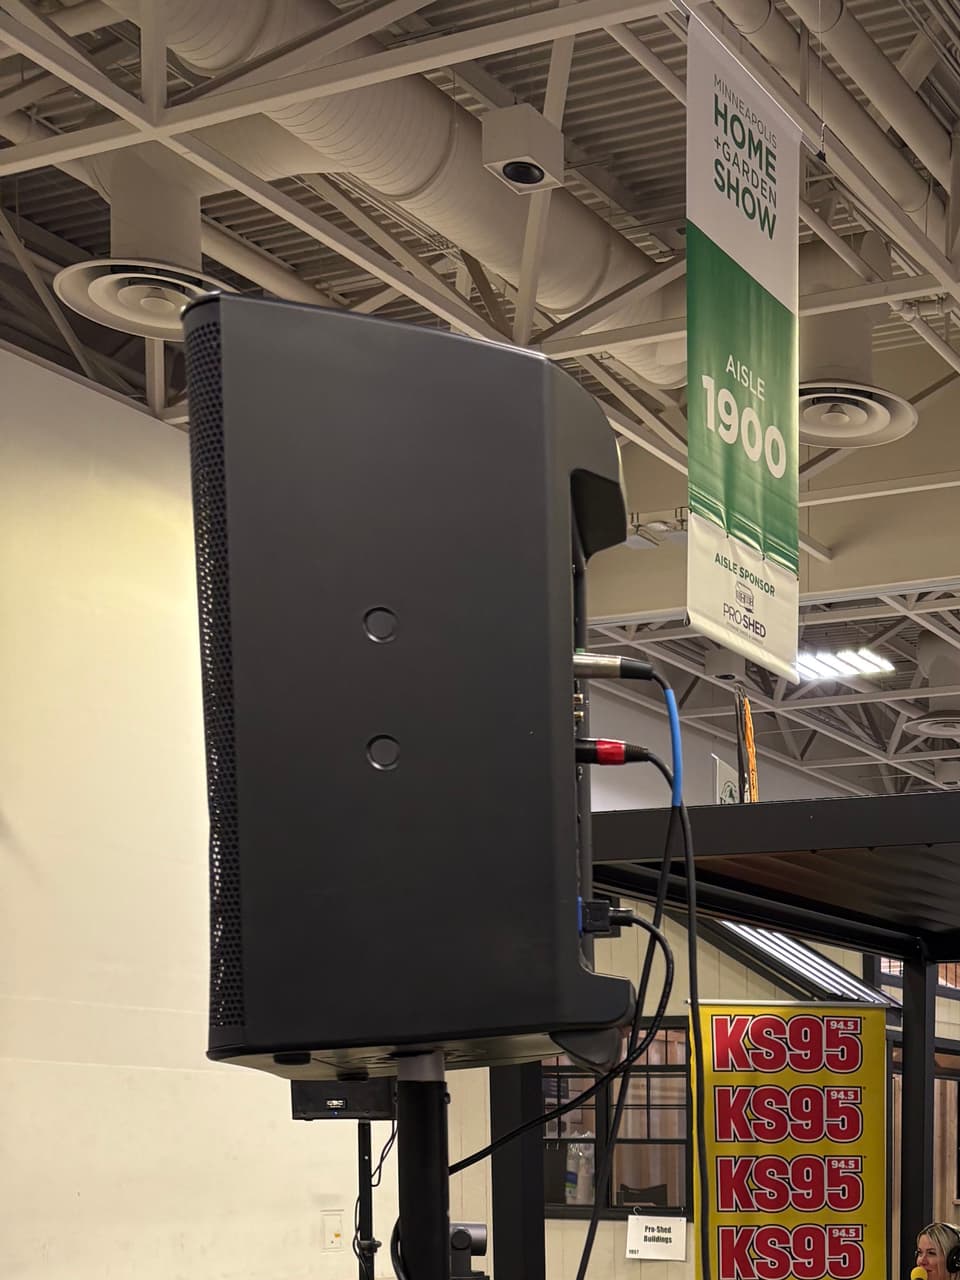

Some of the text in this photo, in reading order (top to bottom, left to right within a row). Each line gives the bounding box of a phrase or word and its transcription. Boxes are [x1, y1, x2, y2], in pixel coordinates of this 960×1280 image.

[714, 74, 777, 149] MINNEAPOLIS
[714, 93, 777, 185] HOME
[714, 158, 777, 240] SHOW
[726, 355, 765, 401] AISLE
[702, 375, 786, 479] 1900
[715, 553, 775, 597] AISLE SPONSOR
[711, 1014, 863, 1073] KS95
[831, 1021, 854, 1029] 94.5
[714, 1085, 864, 1143] KS95
[831, 1091, 854, 1099] 94.5
[715, 1155, 865, 1212] KS95
[831, 1160, 855, 1169] 94.5
[644, 1235, 672, 1244] Buildings
[717, 1224, 865, 1280] KS95
[832, 1228, 856, 1237] 94.5
